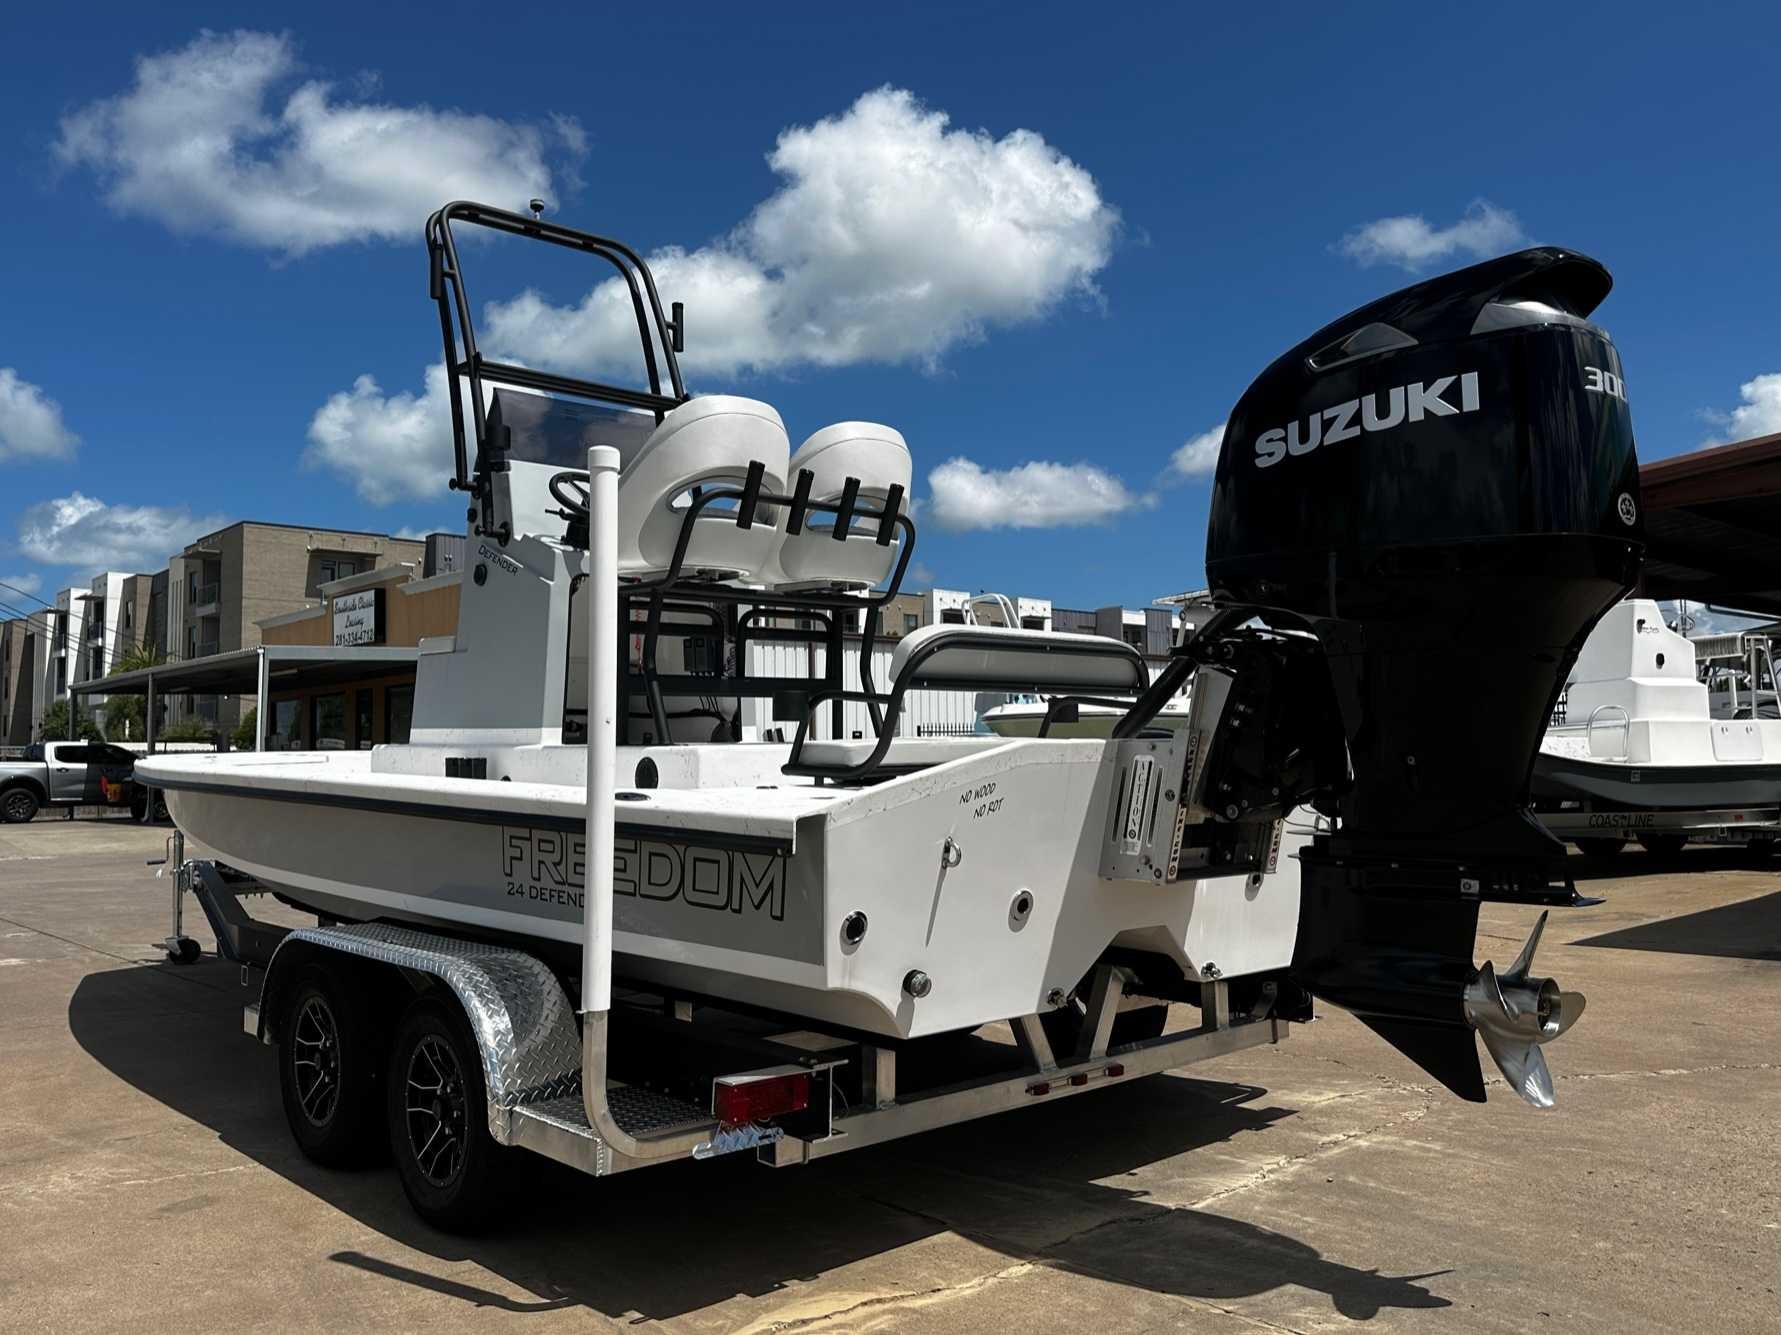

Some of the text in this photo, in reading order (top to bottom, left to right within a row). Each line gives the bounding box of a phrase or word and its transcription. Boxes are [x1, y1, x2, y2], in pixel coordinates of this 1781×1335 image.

[1254, 371, 1480, 468] SUZUKI
[478, 544, 519, 576] DEFENDER
[959, 782, 997, 805] NO WOOD
[973, 797, 1005, 819] NO ROT
[501, 824, 785, 921] FREEDOM
[507, 882, 585, 909] 24 DEFEND
